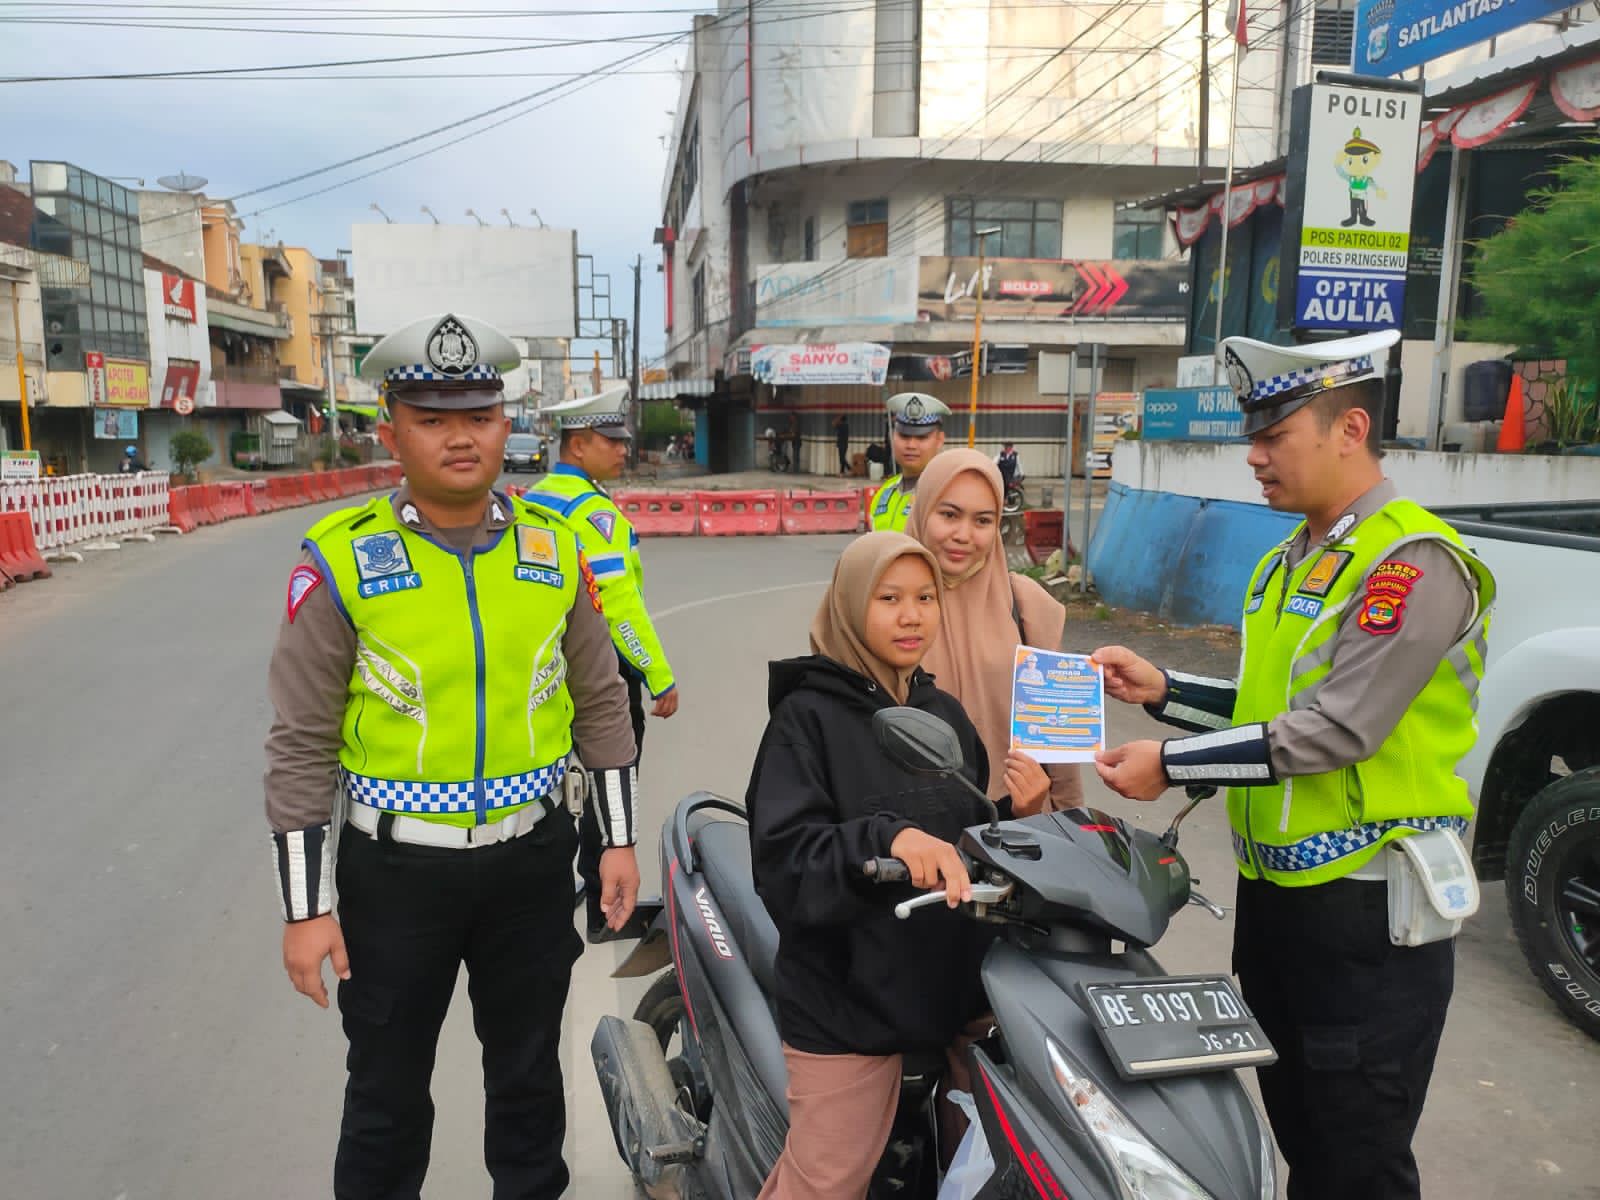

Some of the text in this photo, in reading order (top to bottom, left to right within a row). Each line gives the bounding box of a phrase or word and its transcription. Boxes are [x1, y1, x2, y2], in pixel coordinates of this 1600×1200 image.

[1328, 93, 1407, 120] POLISI
[1310, 230, 1401, 249] POS PATROLI 02
[1303, 250, 1342, 265] POLRES
[1344, 252, 1406, 268] PRINGSEWU
[1315, 280, 1389, 299] OPTIK
[1303, 298, 1395, 323] AULIA
[789, 352, 849, 365] SANYO
[1146, 402, 1177, 414] oppo
[363, 574, 417, 595] ERIK
[517, 567, 562, 588] POLRI
[695, 886, 733, 958] VARIO
[1102, 990, 1241, 1026] BE 8197 ZD
